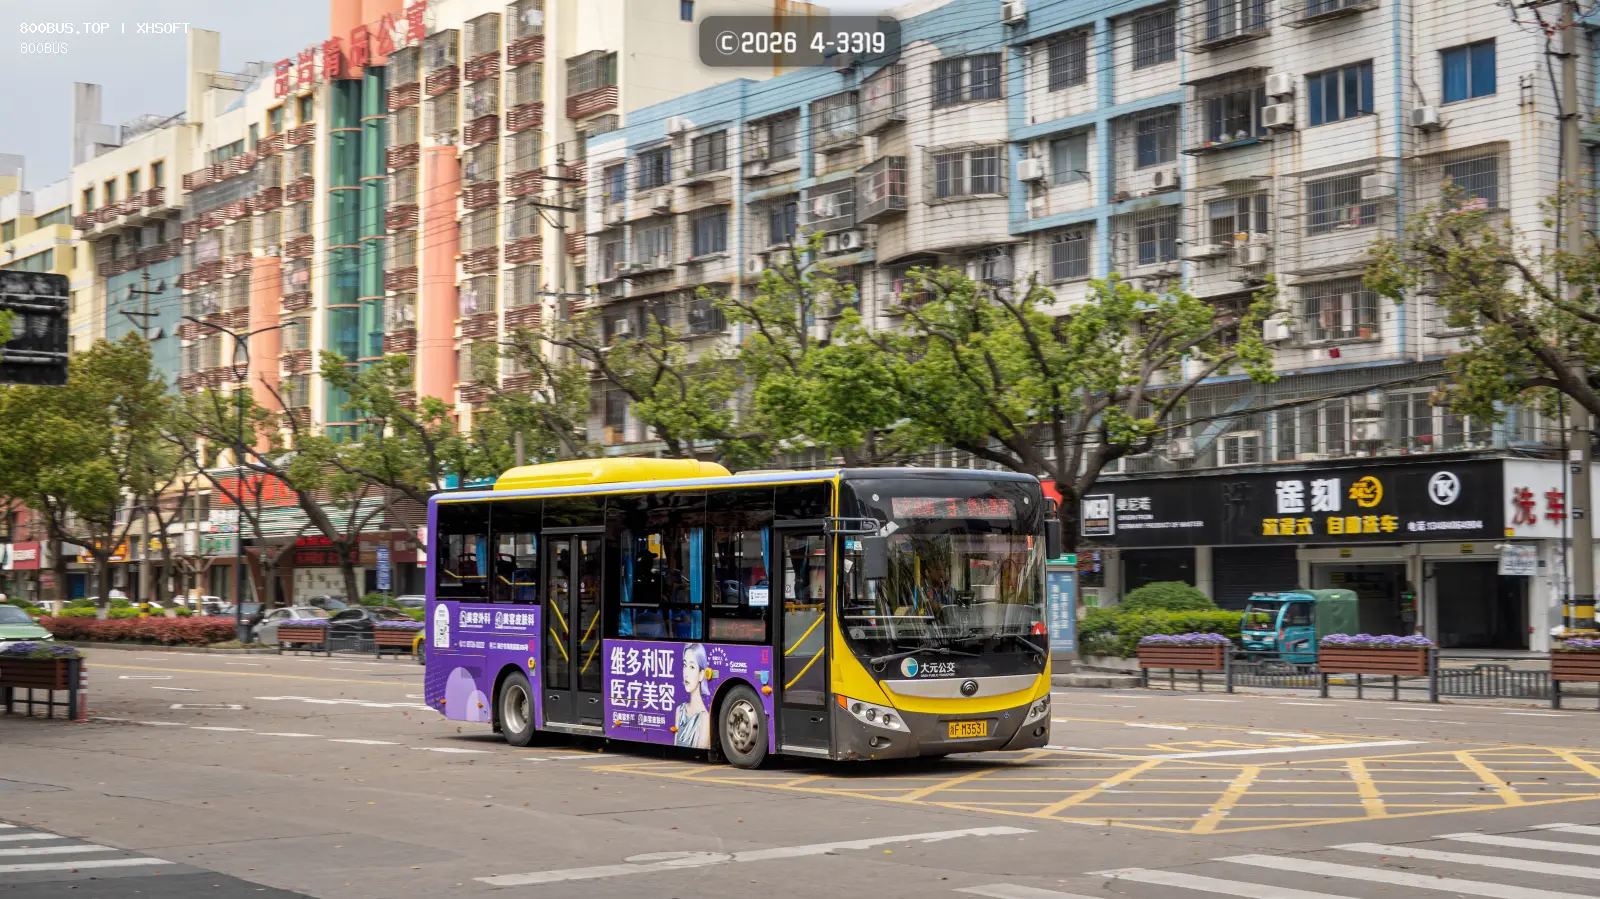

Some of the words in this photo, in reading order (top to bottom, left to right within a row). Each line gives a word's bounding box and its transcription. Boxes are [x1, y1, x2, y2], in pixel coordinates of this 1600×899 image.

[275, 1, 426, 98] 品尚精品公寓
[1512, 486, 1568, 526] 洗车
[611, 646, 675, 679] 维多利亚
[920, 662, 956, 673] 大元公交
[610, 679, 676, 712] 医疗美容
